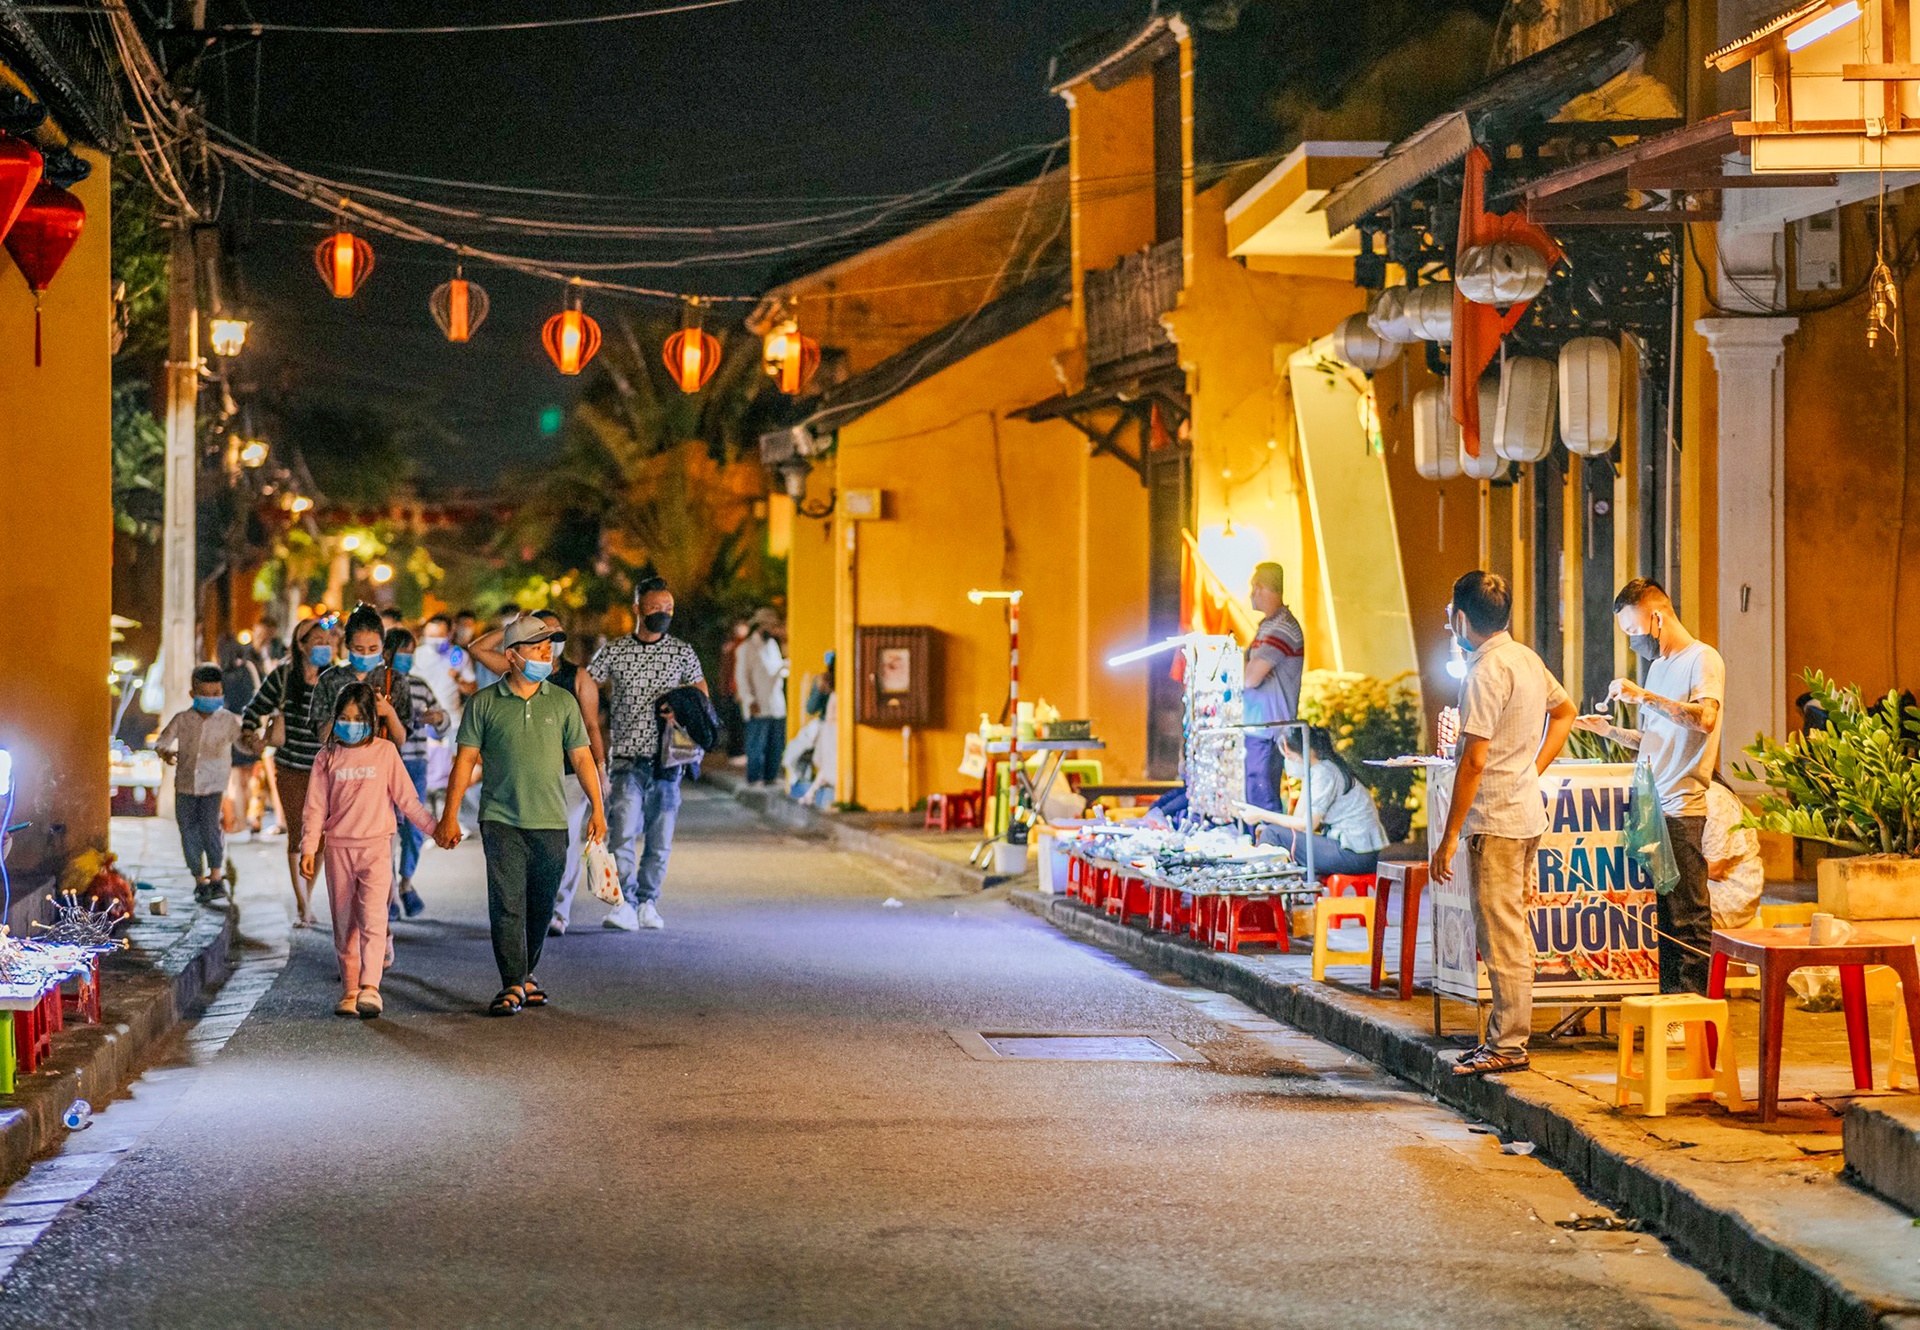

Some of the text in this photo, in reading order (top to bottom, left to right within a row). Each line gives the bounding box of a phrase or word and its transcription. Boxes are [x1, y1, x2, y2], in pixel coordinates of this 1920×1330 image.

[335, 766, 376, 781] NICE
[1540, 778, 1638, 833] ÁNH
[1537, 838, 1655, 893] RÁNG
